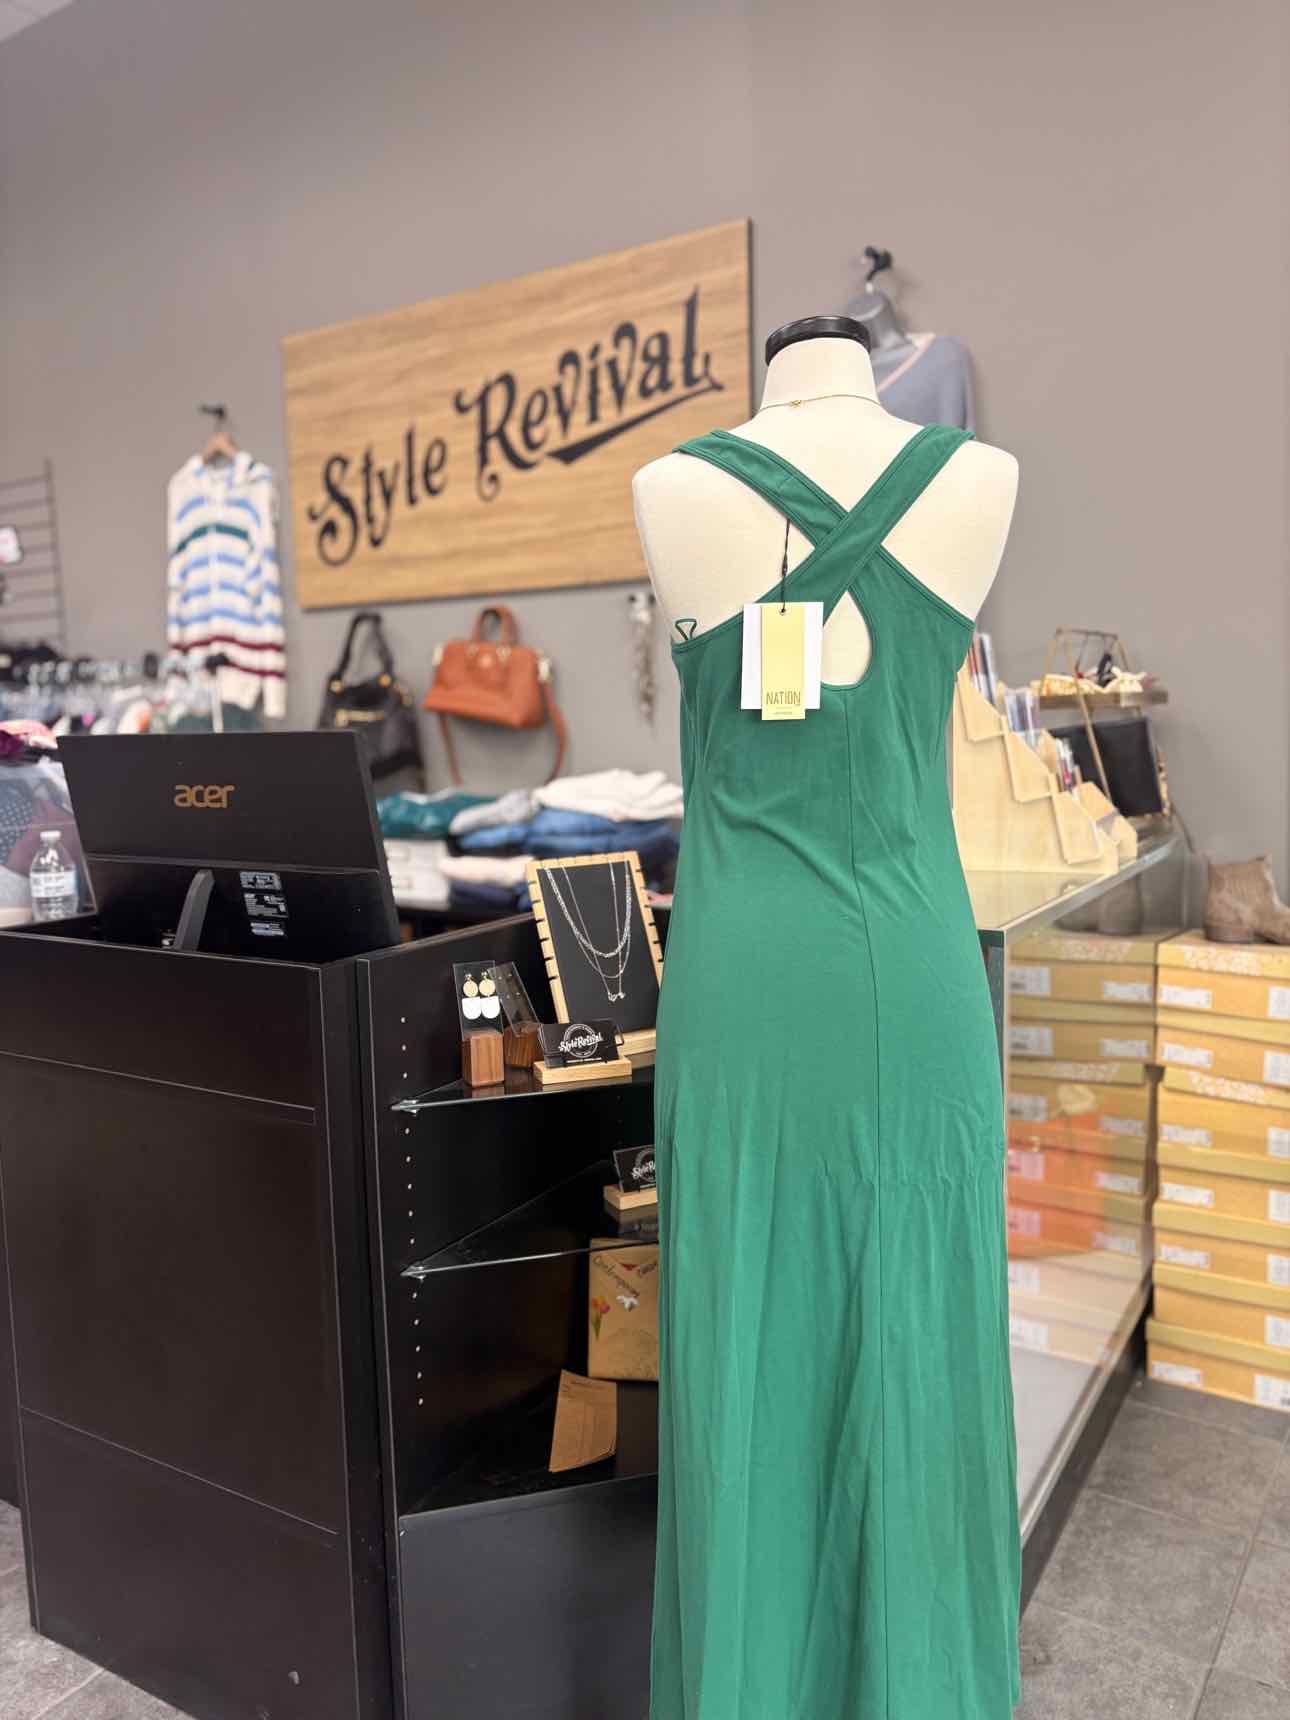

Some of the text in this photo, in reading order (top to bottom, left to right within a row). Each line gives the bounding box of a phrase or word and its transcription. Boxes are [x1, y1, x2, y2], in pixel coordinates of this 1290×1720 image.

[308, 283, 720, 567] Style Revival
[766, 690, 801, 705] NATION
[174, 784, 235, 808] acer
